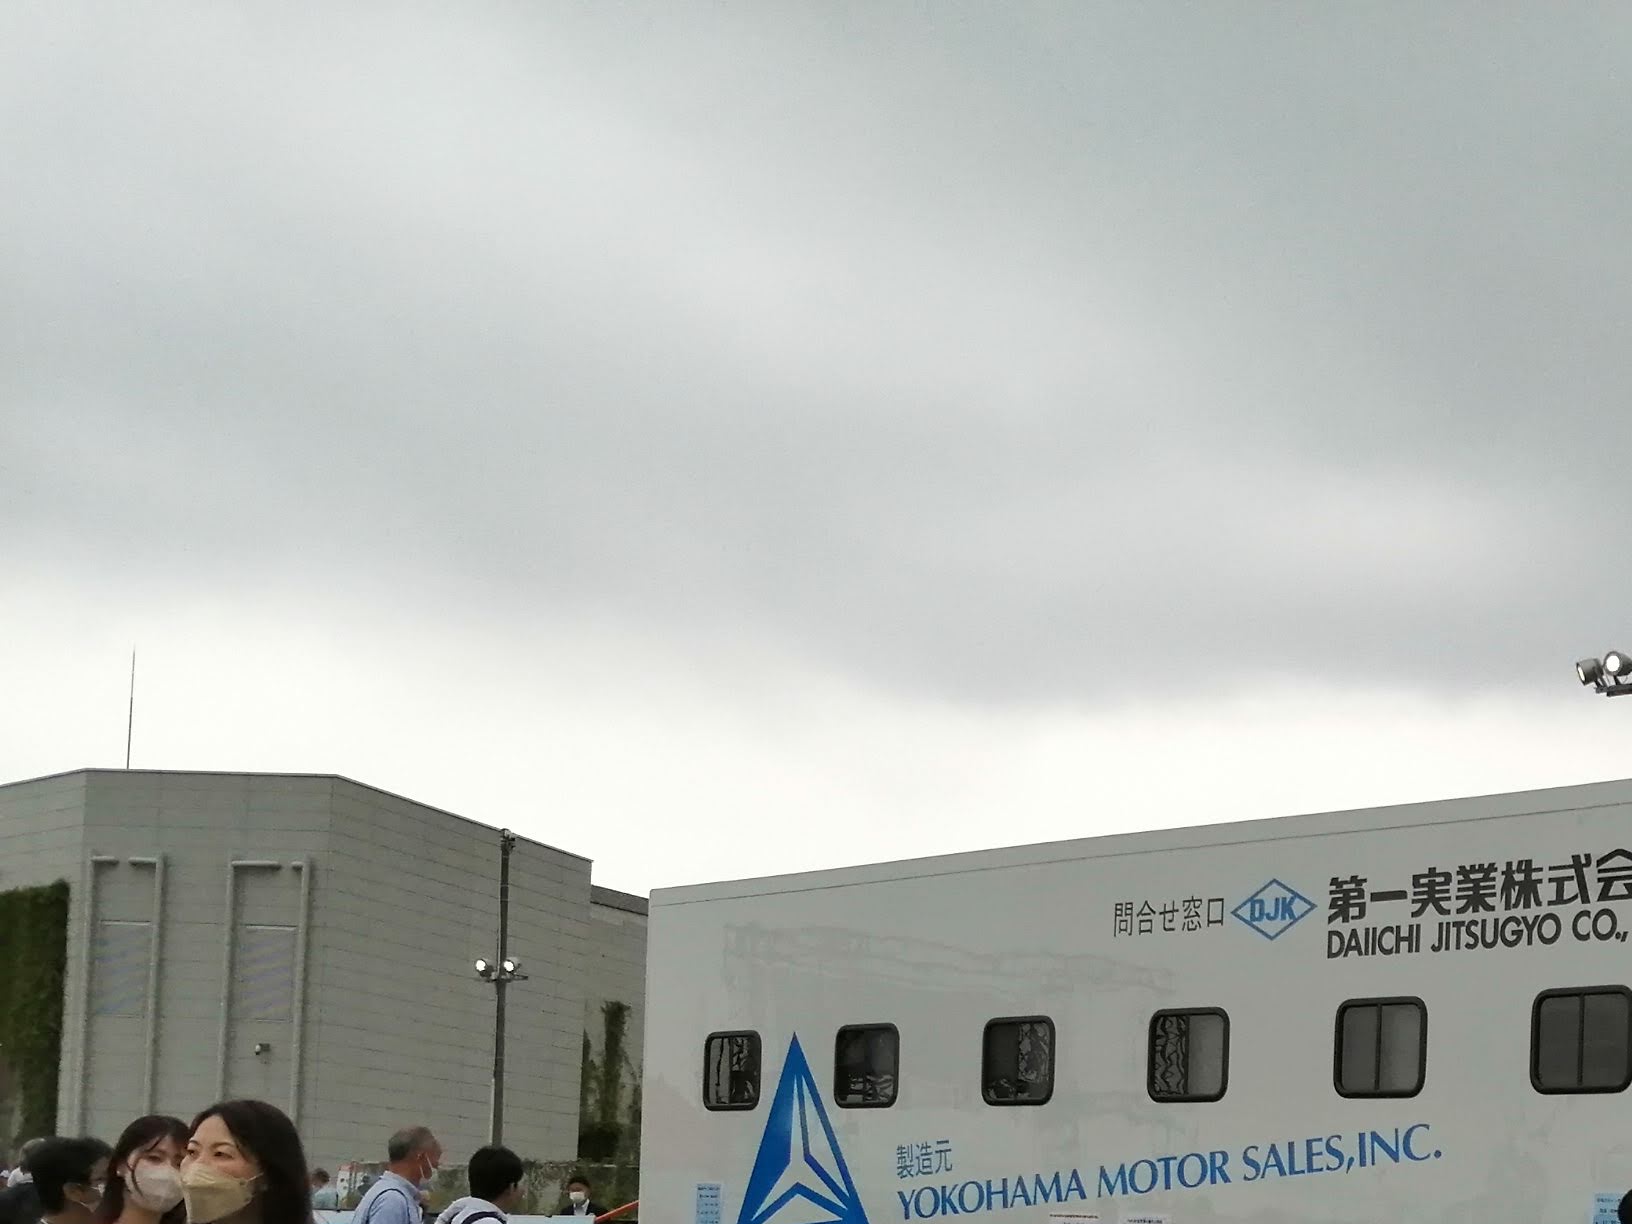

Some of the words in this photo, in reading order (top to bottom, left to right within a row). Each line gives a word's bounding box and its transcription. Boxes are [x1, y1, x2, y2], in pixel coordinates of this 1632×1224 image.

[1112, 894, 1226, 938] 問合せ窓口
[1249, 895, 1298, 923] DJK
[1326, 923, 1422, 960] DAIICHI
[1430, 911, 1563, 954] JITSUGYO
[895, 1138, 953, 1180] 製造元
[896, 1167, 1088, 1221] YOKOHAMA
[1097, 1149, 1232, 1199] MOTOR
